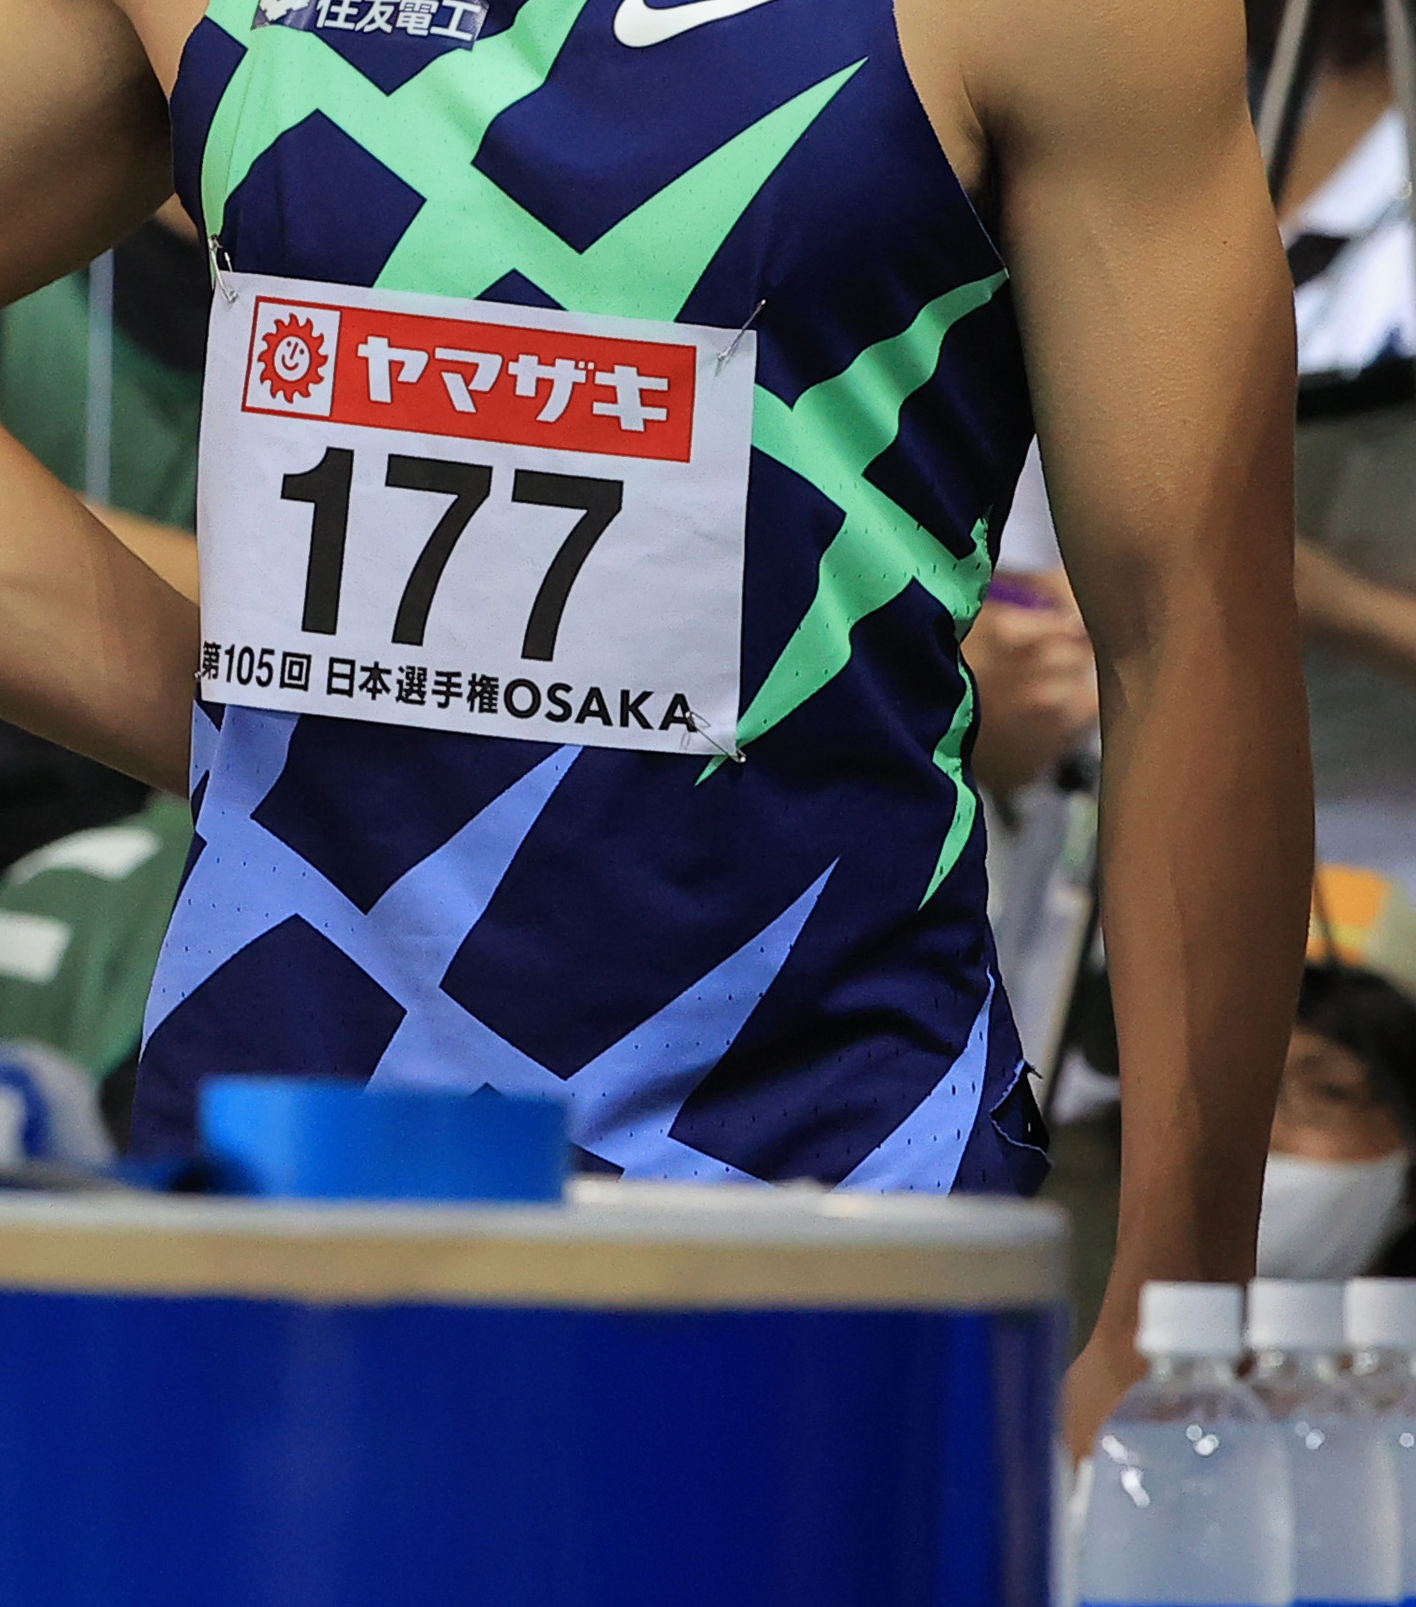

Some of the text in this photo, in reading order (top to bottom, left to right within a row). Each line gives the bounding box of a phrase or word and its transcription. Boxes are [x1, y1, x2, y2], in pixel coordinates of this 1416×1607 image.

[357, 335, 671, 433] ヤマザキ
[279, 446, 624, 663] 177
[200, 640, 313, 692] 第105回
